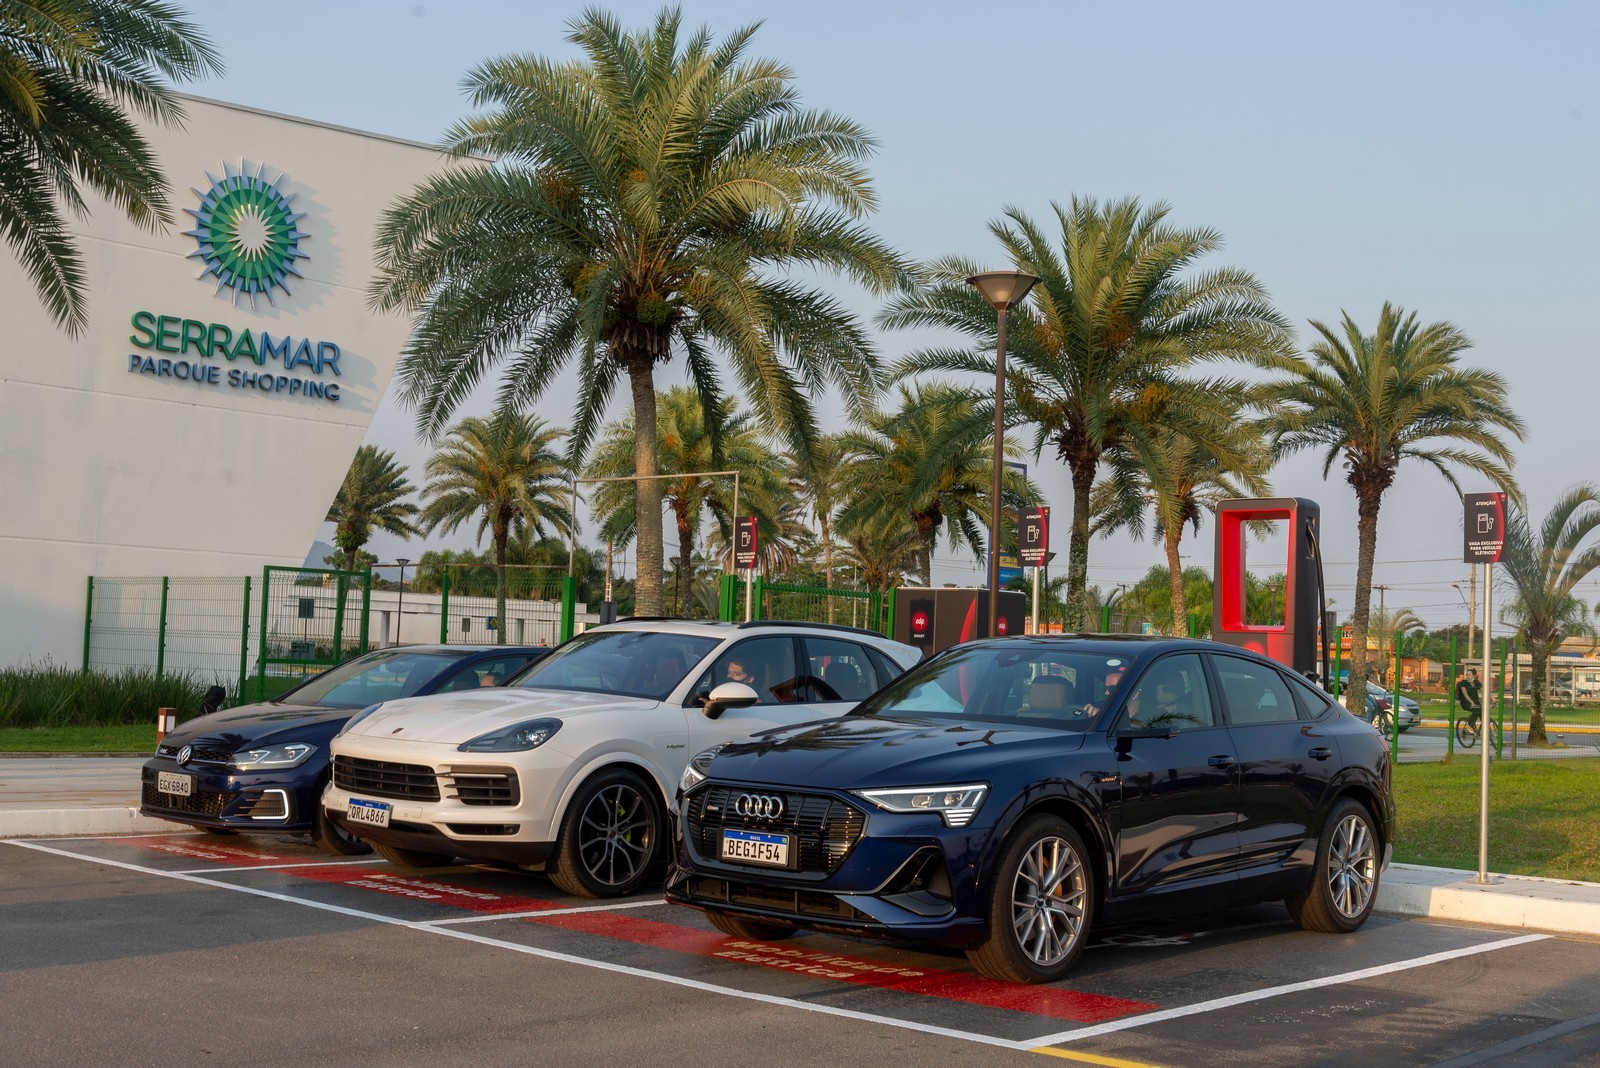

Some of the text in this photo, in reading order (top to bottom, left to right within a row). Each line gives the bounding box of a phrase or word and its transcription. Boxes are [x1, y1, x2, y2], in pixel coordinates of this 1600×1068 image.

[129, 311, 341, 376] SERRAMAR
[128, 354, 340, 400] PARQUE SHOPPING
[351, 806, 385, 824] QRL4B66
[728, 839, 780, 861] BEG1F54
[723, 941, 925, 976] Mobilidade
